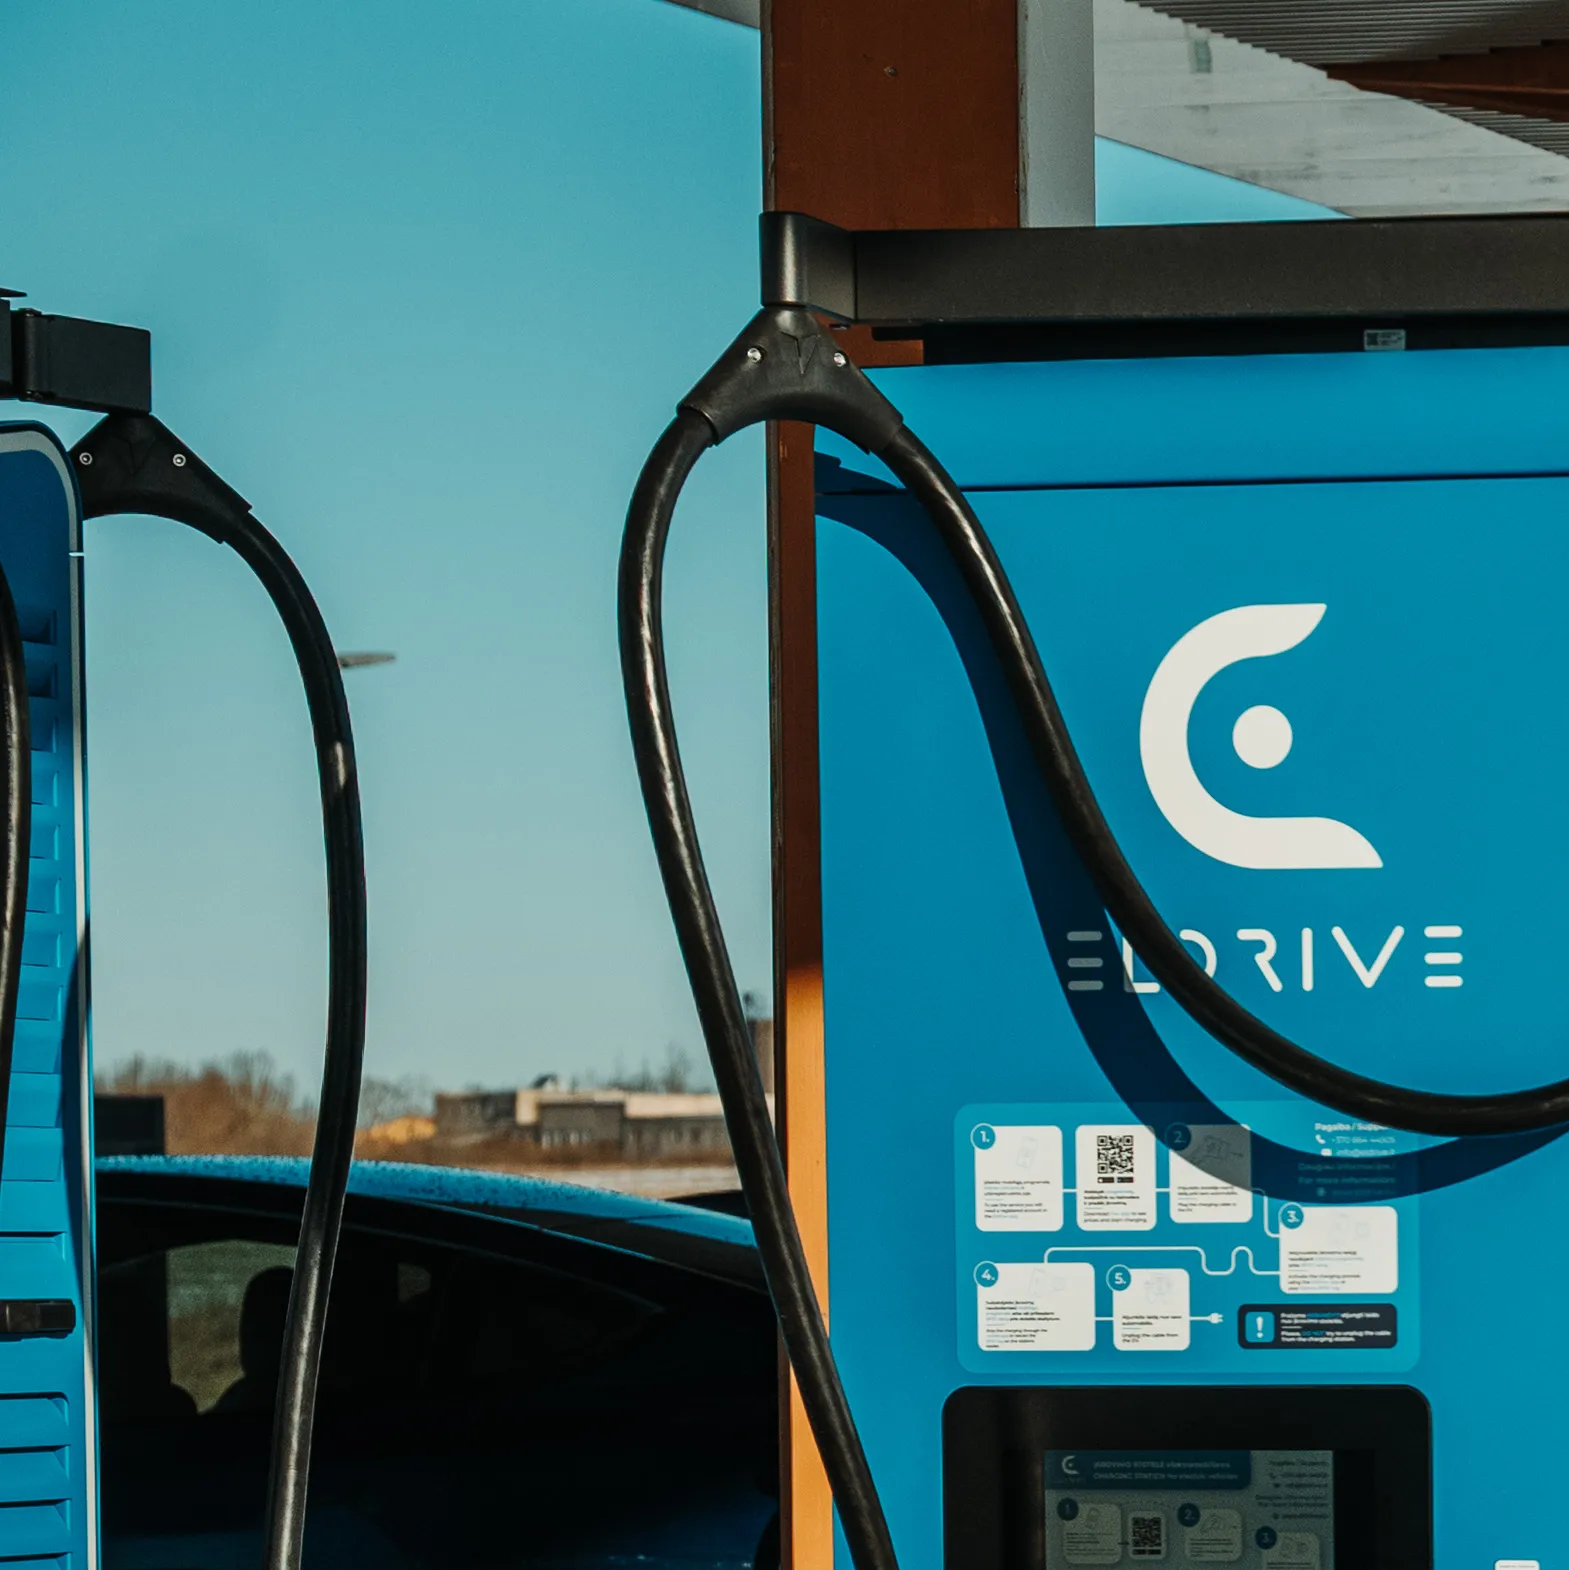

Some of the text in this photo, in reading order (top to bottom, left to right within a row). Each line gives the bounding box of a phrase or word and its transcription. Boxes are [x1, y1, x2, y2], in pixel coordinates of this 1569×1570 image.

[979, 1131, 990, 1143] 1.
[1173, 1131, 1186, 1143] 2.
[1287, 1210, 1299, 1223] 3.
[981, 1269, 995, 1280] 4.
[1114, 1272, 1126, 1284] 5.
